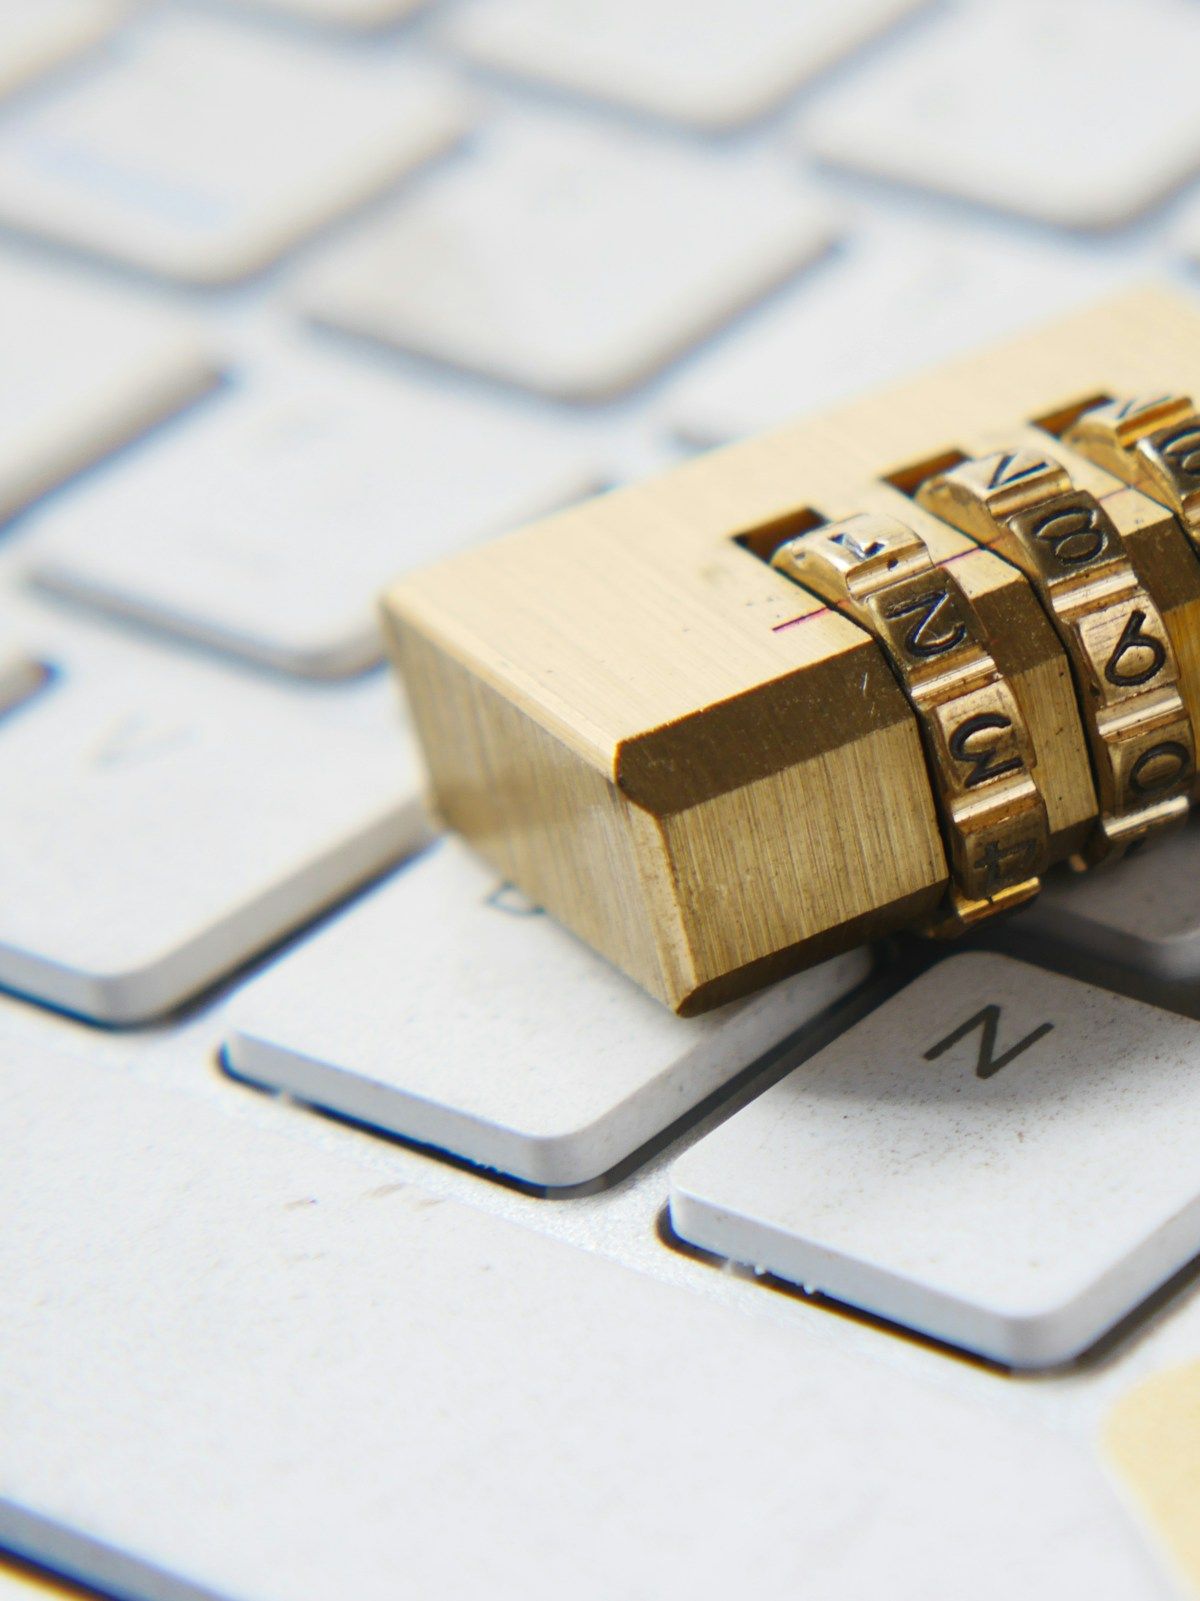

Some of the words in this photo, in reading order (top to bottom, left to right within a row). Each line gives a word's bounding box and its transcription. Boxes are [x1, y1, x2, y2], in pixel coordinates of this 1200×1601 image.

[1032, 506, 1110, 566] 8
[884, 590, 968, 658] 2
[950, 711, 1025, 789] 3
[923, 1003, 1055, 1080] N
